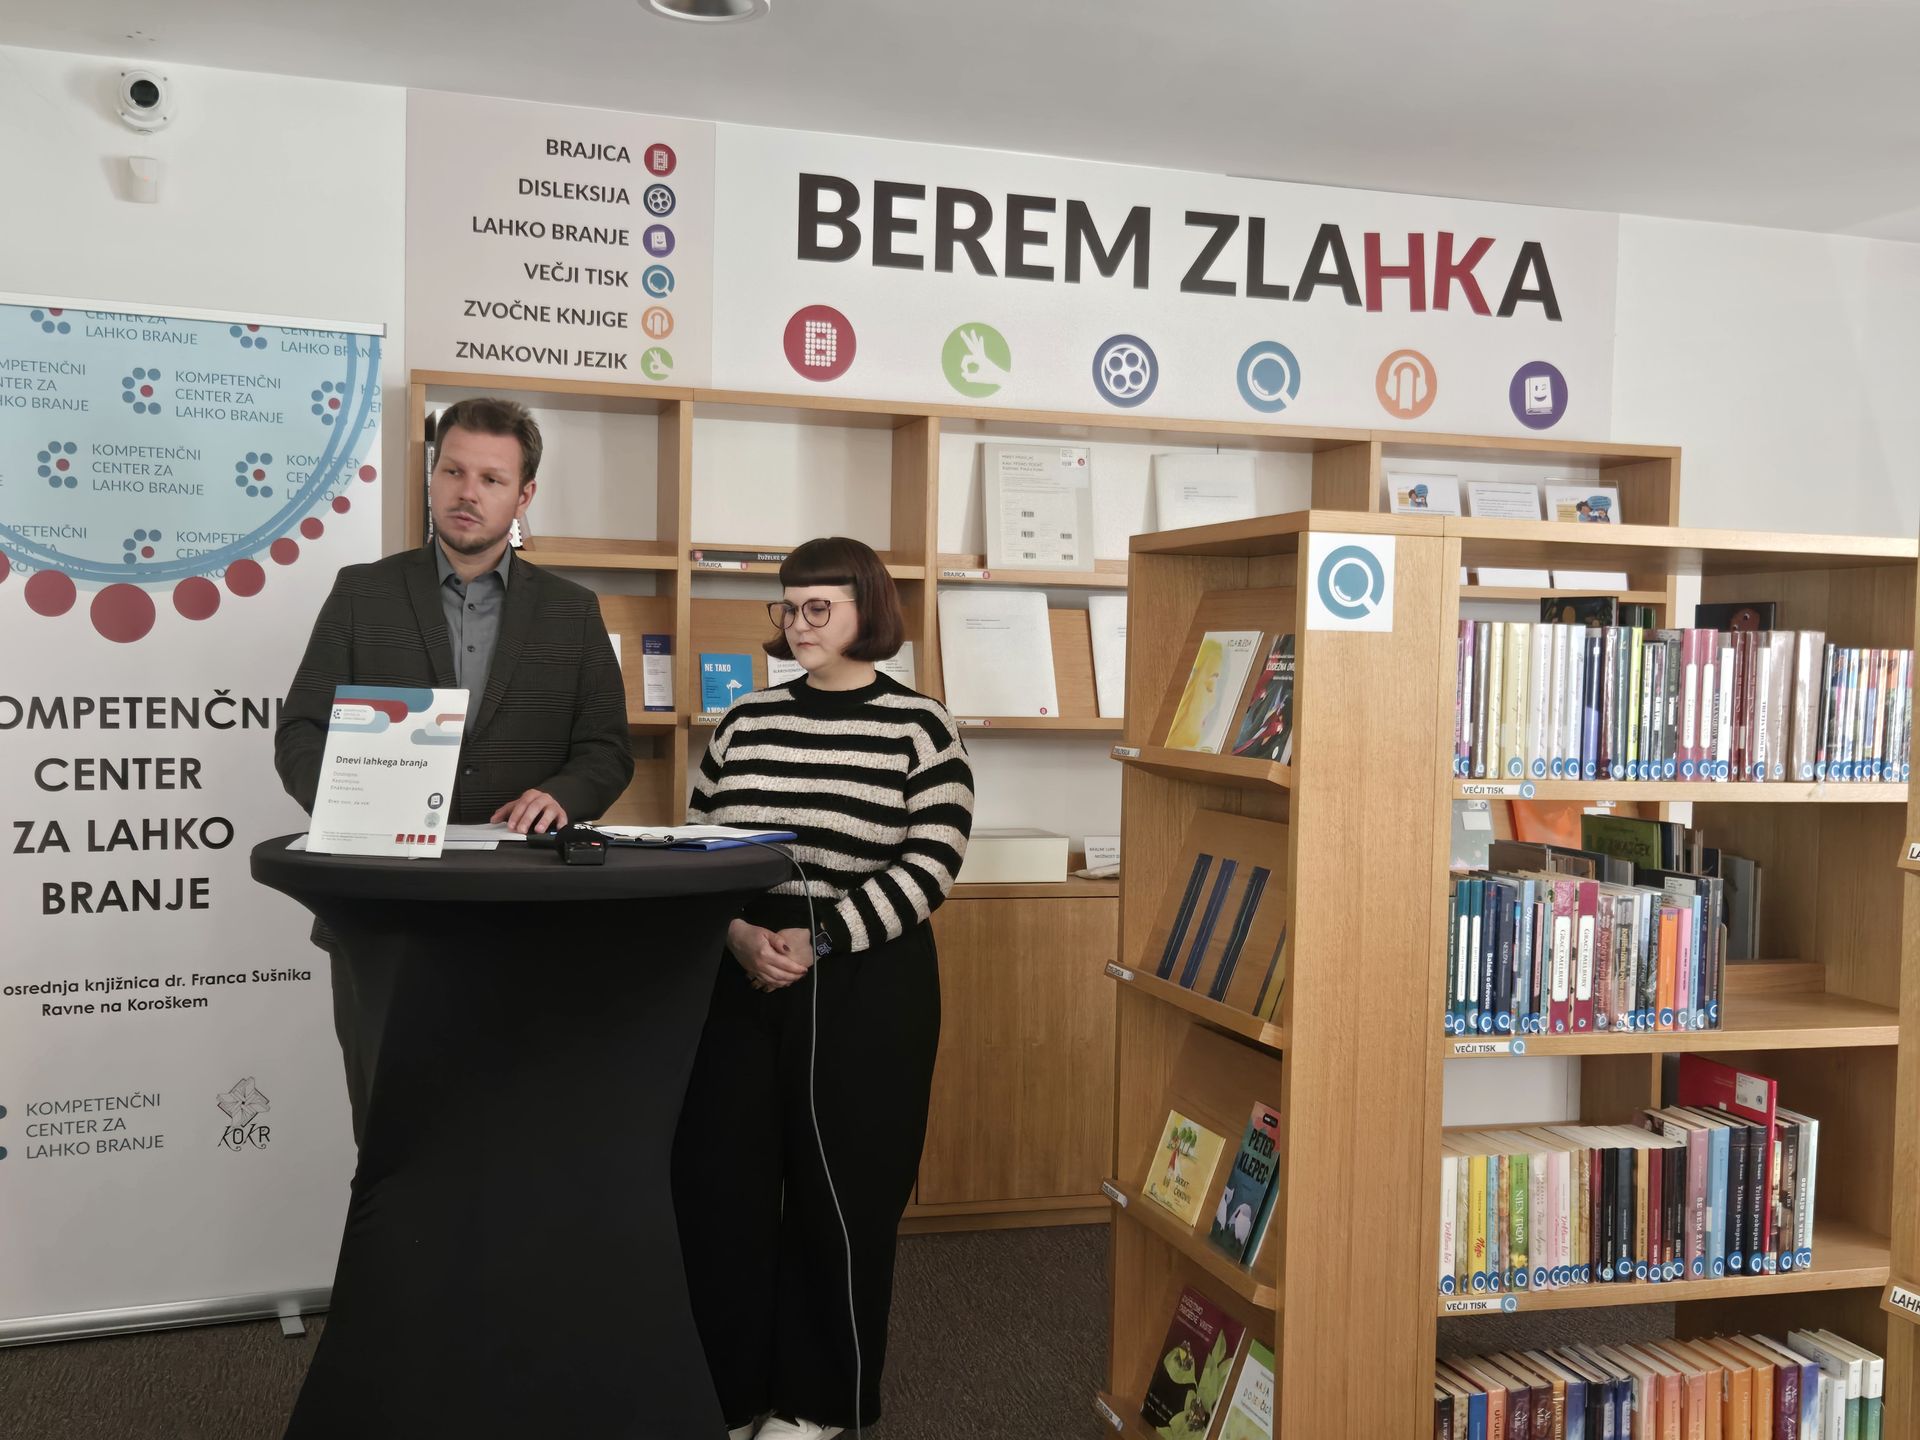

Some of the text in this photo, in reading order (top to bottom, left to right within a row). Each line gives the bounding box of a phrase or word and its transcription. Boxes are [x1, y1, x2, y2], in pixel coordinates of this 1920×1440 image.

[546, 138, 631, 163] BRAJICA
[518, 178, 630, 205] DISLEKSIJA
[472, 216, 630, 246] LAHKO BRANJE
[796, 172, 1562, 322] BEREM ZLAHKA
[524, 262, 628, 287] VEČJI TISK
[464, 300, 628, 328] ZVOČNE KNJIGE
[86, 325, 199, 344] LAHKO BRANJE
[281, 341, 330, 355] LAHKO
[456, 341, 628, 370] ZNAKOVNI JEZIK
[37, 379, 57, 391] ZA
[175, 370, 281, 389] KOMPETENČNI
[32, 397, 89, 412] BRANJE
[175, 388, 254, 404] CENTER ZA
[175, 405, 284, 424] LAHKO BRANJE
[91, 443, 201, 460] KOMPETENČNI
[91, 461, 173, 476] CENTER ZA
[92, 480, 204, 496] LAHKO BRANJE
[704, 664, 731, 672] NE TAKO
[336, 756, 428, 768] Dnevi lahkega branja
[34, 757, 203, 792] CENTER
[1464, 785, 1484, 794] VEČJI
[13, 816, 234, 854] ZA LAHKO
[42, 877, 210, 915] BRANJE
[3, 967, 311, 997] osrednja knjižnica dr. Franca Sušnika
[42, 994, 208, 1017] Ravne na Koroškem
[1455, 1043, 1496, 1053] VEČJI TISK
[26, 1092, 161, 1116] KOMPETENČNI
[26, 1118, 126, 1138] CENTER ZA
[217, 1123, 270, 1152] KOKR
[26, 1135, 164, 1159] LAHKO BRANJE
[1248, 1128, 1275, 1159] PETER
[1237, 1151, 1269, 1184] KLEPEC
[1516, 1217, 1524, 1243] TROP
[1447, 1302, 1468, 1310] VEČJI
